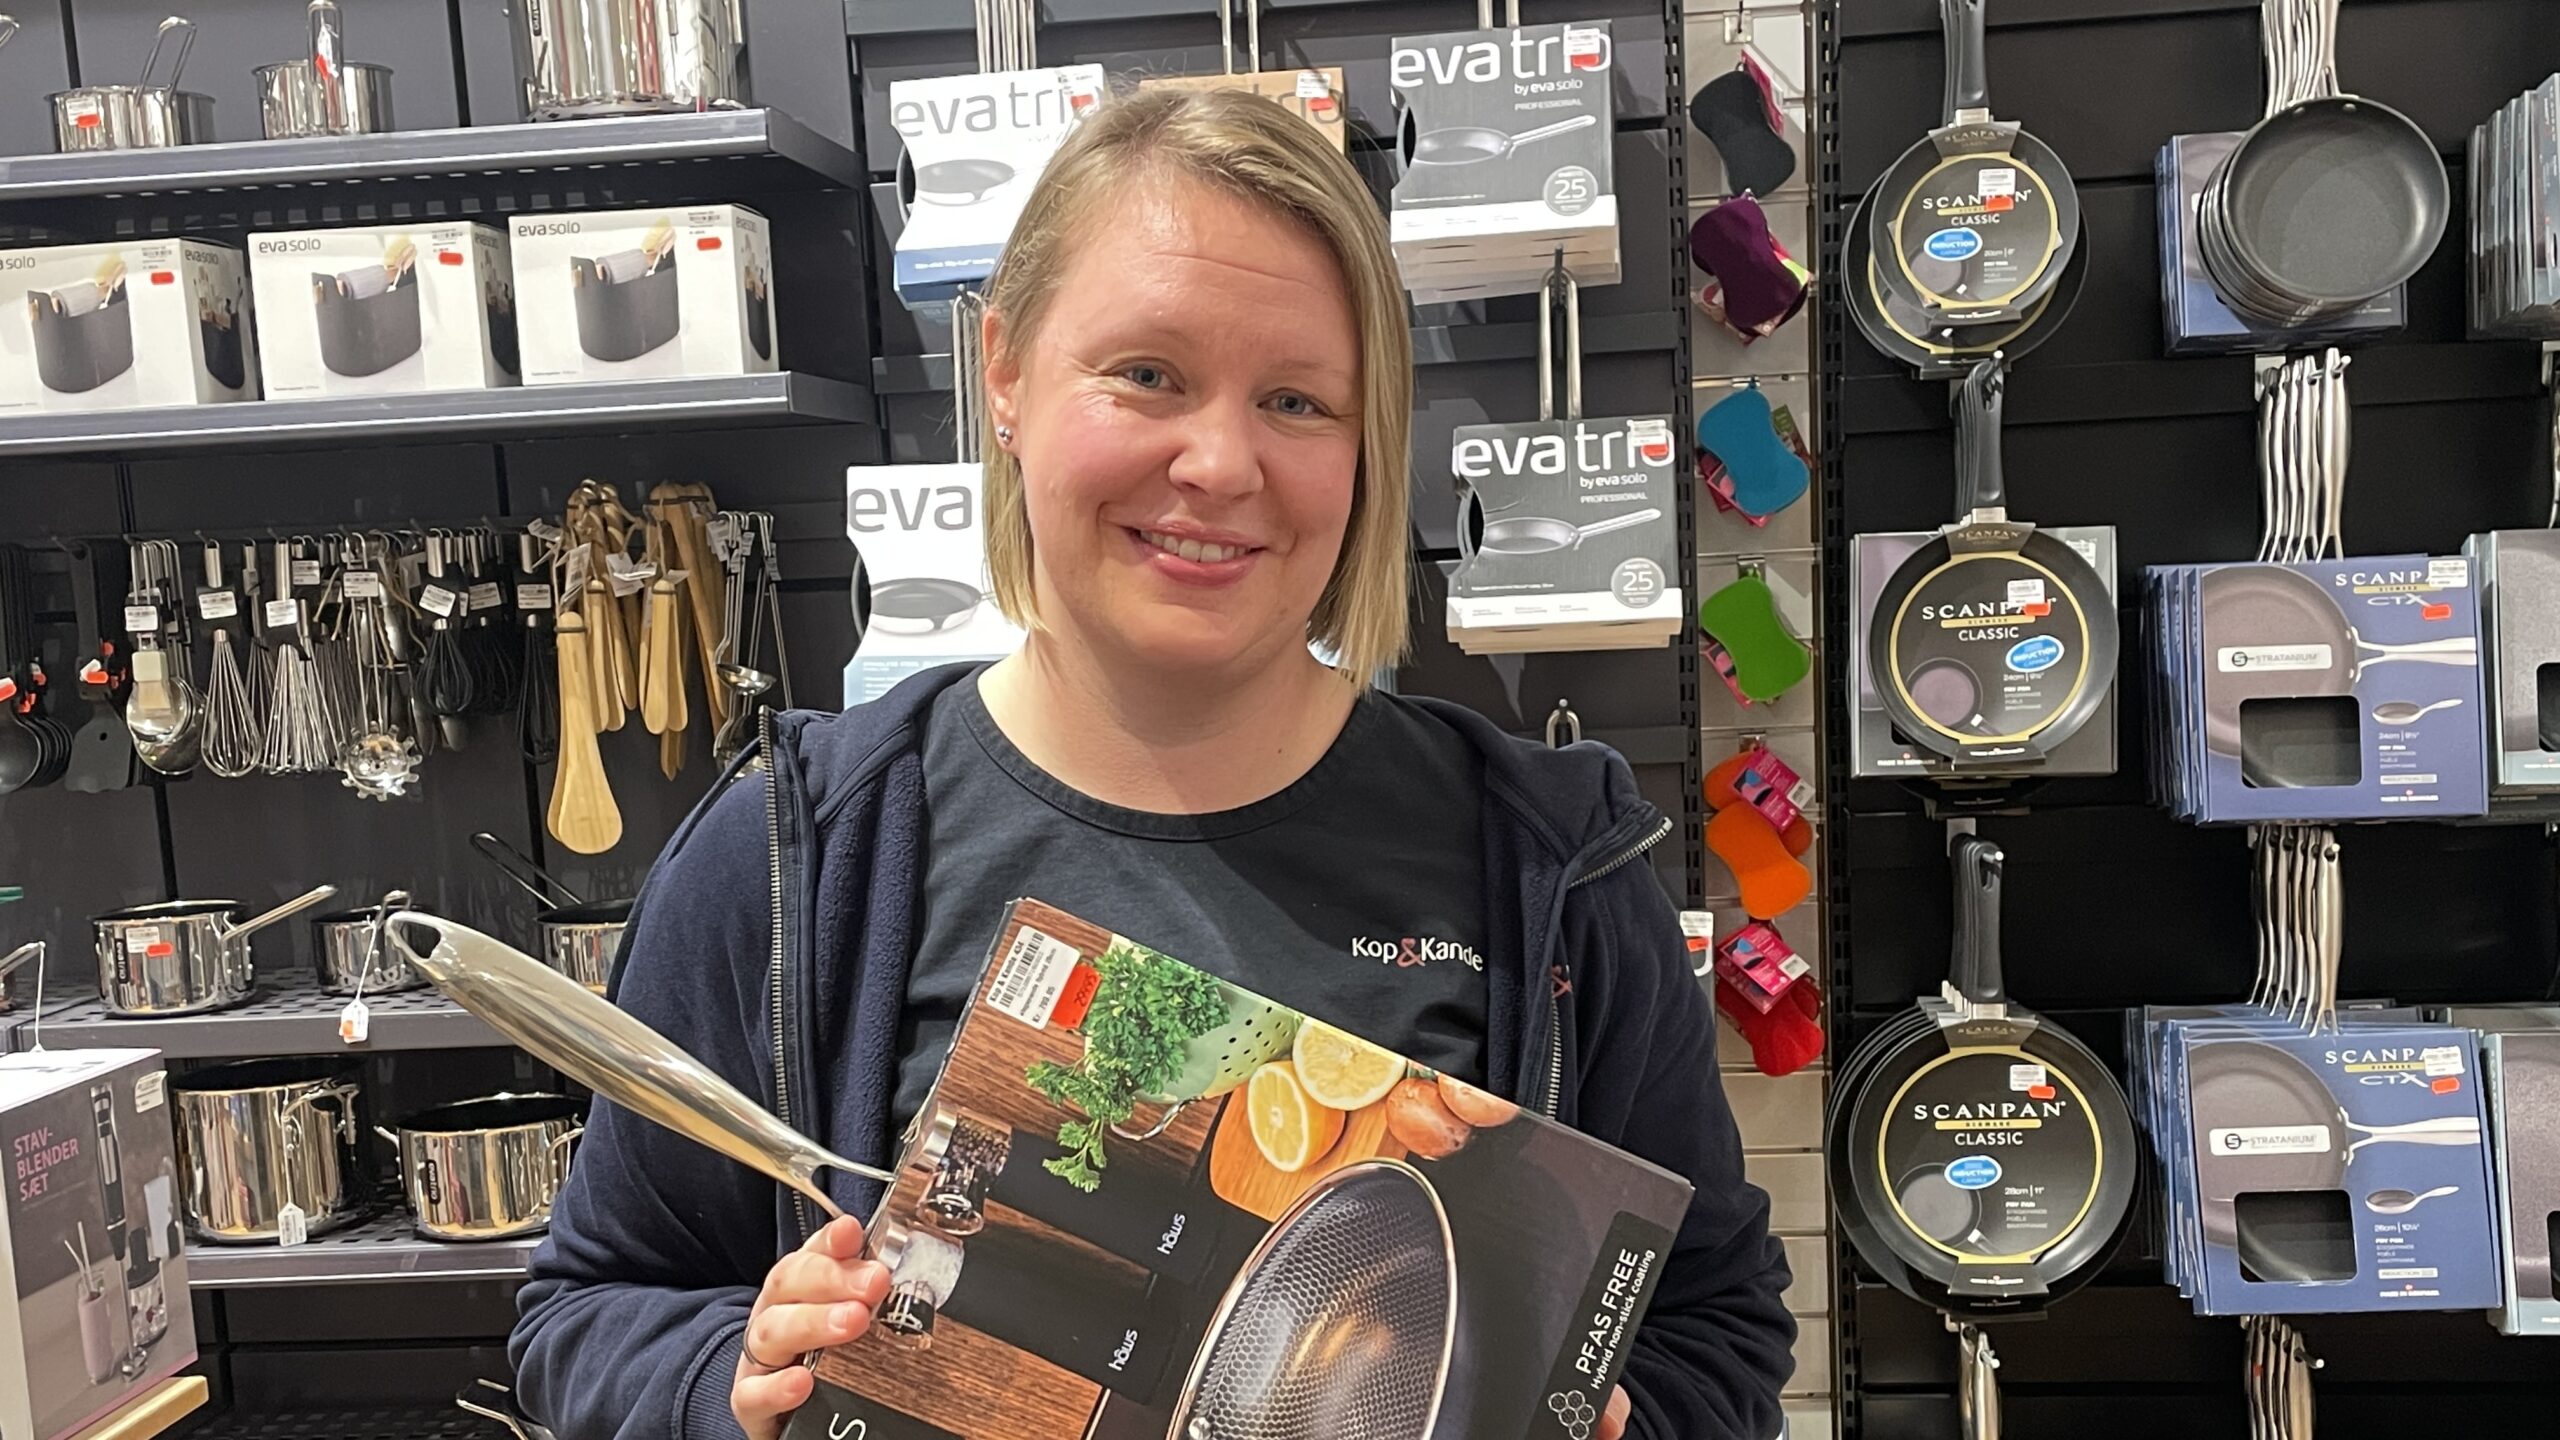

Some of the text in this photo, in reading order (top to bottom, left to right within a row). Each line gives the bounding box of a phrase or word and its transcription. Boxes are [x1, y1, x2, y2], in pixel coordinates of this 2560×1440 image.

[1391, 41, 1500, 88] eva
[1514, 83, 1529, 96] by
[893, 82, 1101, 137] eva tri
[1514, 98, 1583, 111] PROFESSIONAL
[1554, 179, 1588, 200] 25
[1922, 190, 2030, 210] SCANN
[1951, 213, 2000, 226] CLASSIC
[1457, 434, 1566, 477] eva
[1579, 476, 1595, 490] by
[1580, 491, 1648, 504] PROFESSIONAL
[848, 485, 973, 533] eva
[1622, 571, 1654, 592] 25
[2335, 571, 2429, 586] SCANP
[2367, 593, 2432, 606] CTX
[1958, 627, 2019, 641] CLASSIC
[2256, 653, 2319, 663] STRATANIUM
[989, 988, 1002, 1002] Kop
[1002, 956, 1017, 979] Kande
[2325, 1048, 2425, 1064] SCANP
[2359, 1072, 2429, 1088] CTX
[1914, 1102, 2063, 1120] SCANPAN
[14, 1127, 53, 1157] STAV-
[1955, 1132, 2023, 1145] CLASSIC
[2250, 1135, 2317, 1146] STRATANIUM
[17, 1138, 79, 1179] BLENDER
[20, 1173, 48, 1201] SÆT
[1575, 1248, 1639, 1375] PFAS FREE
[1590, 1249, 1656, 1390] Hybrid non-stick coating
